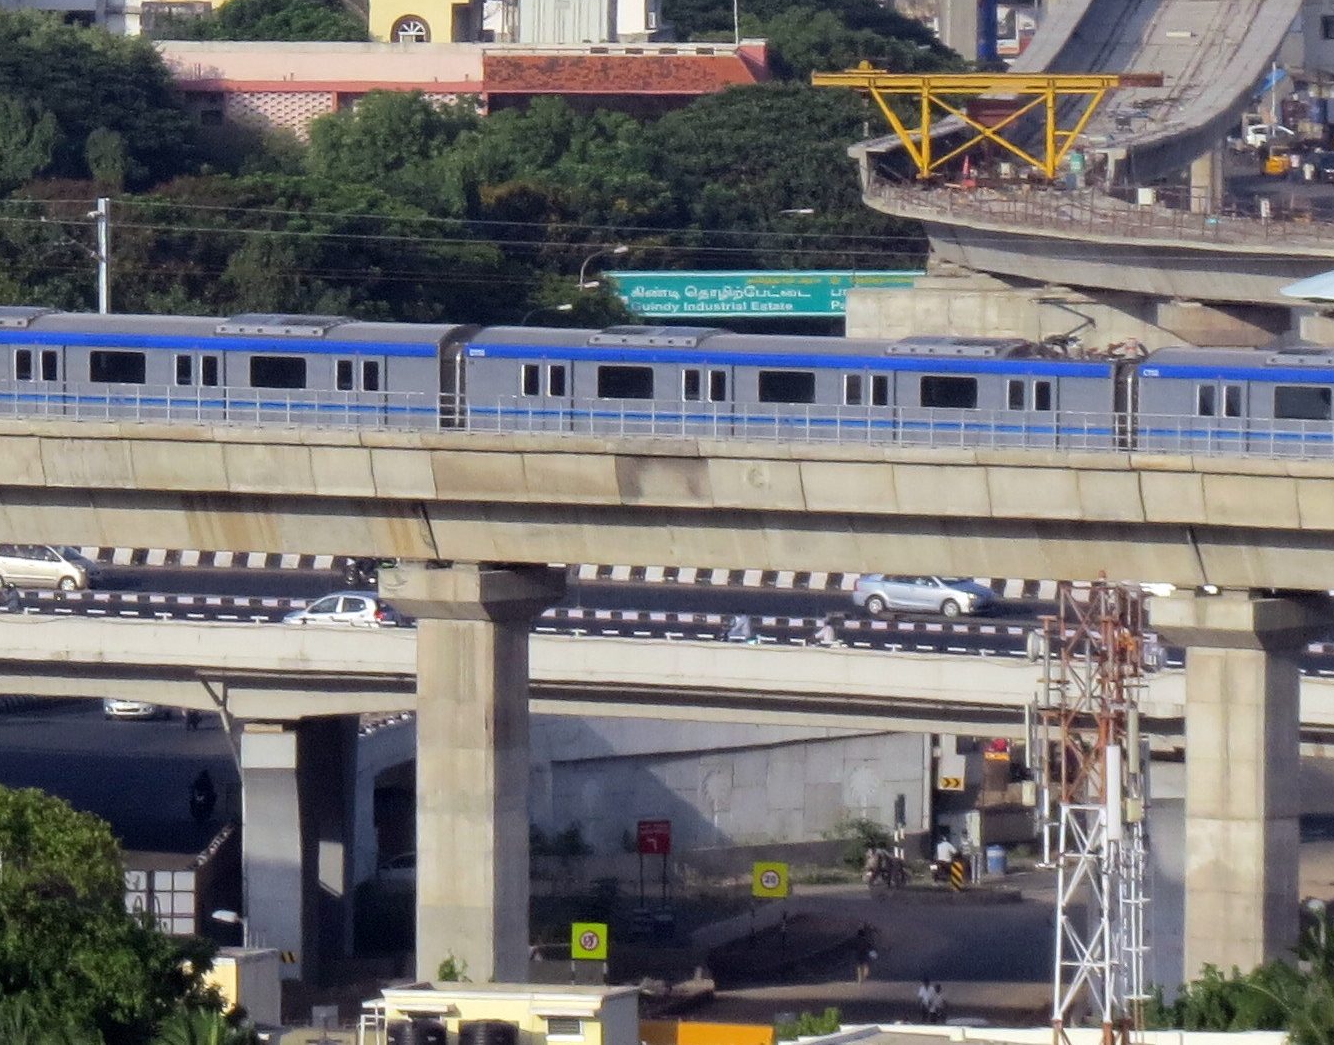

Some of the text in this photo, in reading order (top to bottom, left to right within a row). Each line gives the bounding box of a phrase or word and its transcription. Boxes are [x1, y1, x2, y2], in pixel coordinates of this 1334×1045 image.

[631, 302, 679, 313] Guindy
[683, 301, 747, 311] Industrial
[752, 301, 793, 311] Estate
